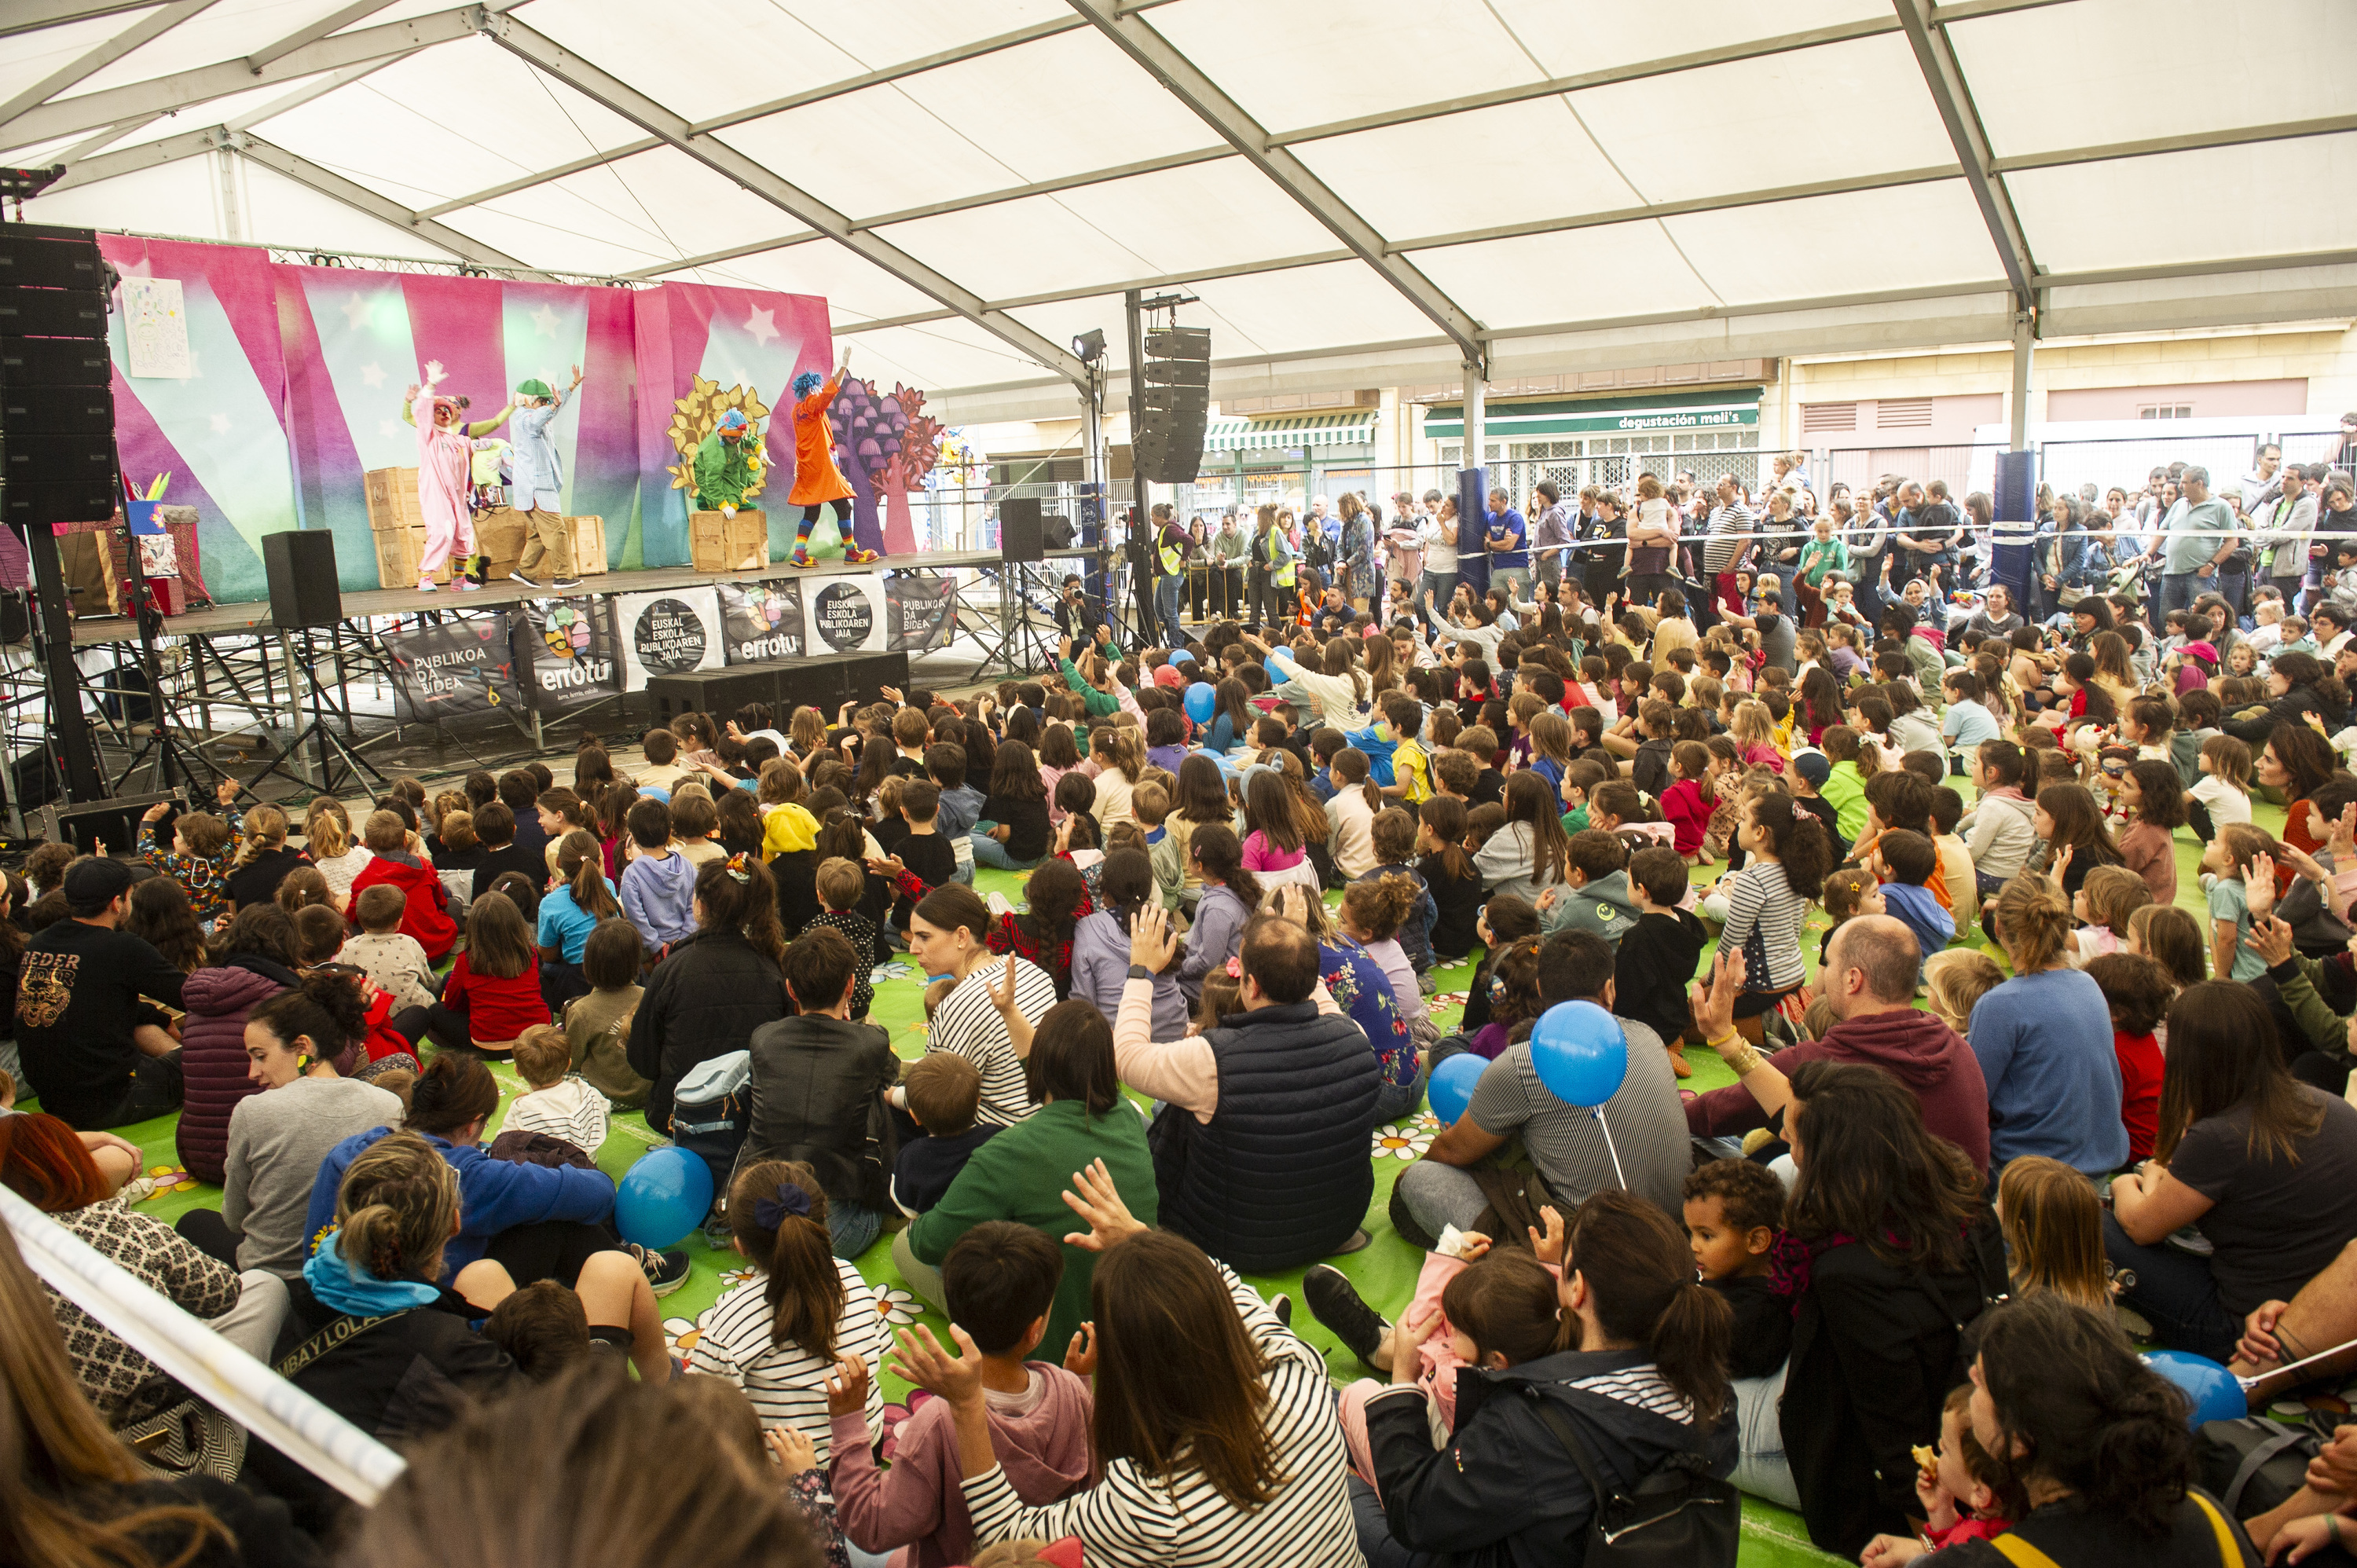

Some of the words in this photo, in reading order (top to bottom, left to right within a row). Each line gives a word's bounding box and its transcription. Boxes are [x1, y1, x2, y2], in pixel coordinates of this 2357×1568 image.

[1618, 414, 1696, 430] degustación
[1700, 411, 1739, 425] meli's
[827, 599, 857, 610] EUSKAL
[902, 599, 946, 610] PUBLIKOA
[827, 610, 857, 619] ESKOLA
[904, 610, 916, 621] DA
[651, 617, 684, 630] EUSKAL
[819, 618, 869, 629] PUBLIKOAREN
[904, 619, 931, 630] BIDEA
[652, 628, 686, 641] ESKOLA
[834, 628, 852, 638] JAIA
[640, 636, 702, 653] PUBLIKOAREN
[741, 633, 797, 660] errotu
[413, 647, 487, 670] PUBLIKOA
[660, 649, 683, 661] JAIA
[415, 668, 439, 683] DA
[541, 661, 610, 691] errotu
[420, 677, 464, 694] BIDEA
[310, 1336, 321, 1355] Y
